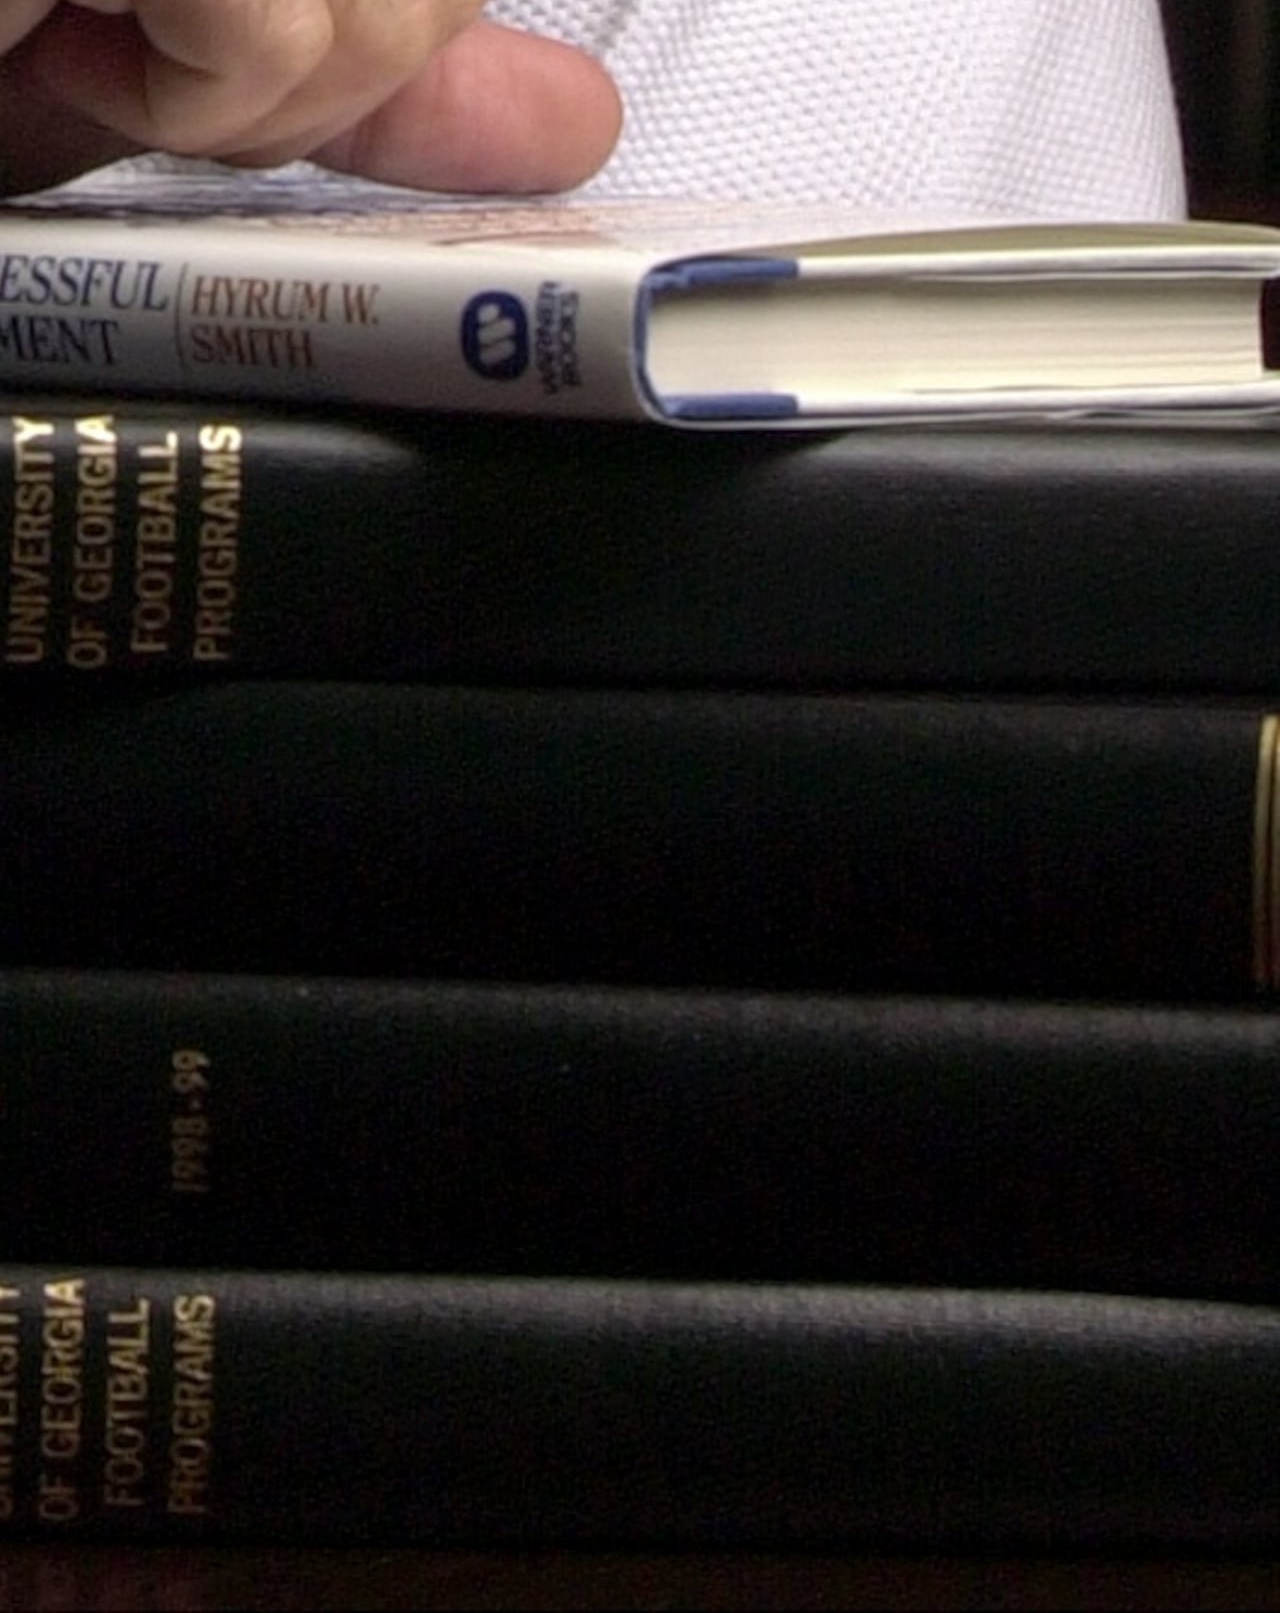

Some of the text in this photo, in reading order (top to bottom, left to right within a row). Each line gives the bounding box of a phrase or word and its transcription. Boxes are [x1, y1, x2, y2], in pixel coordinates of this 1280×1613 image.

[190, 275, 381, 325] HYRUM W.
[191, 326, 315, 368] SMITH
[6, 415, 55, 664] UNIVERSITY
[66, 414, 117, 669] OF GEORGIA
[132, 430, 179, 652] FOOTBALL
[193, 423, 242, 661] PROGRAMS
[39, 1278, 86, 1522] OF GEORGIA
[105, 1297, 152, 1508] FOOTBALL
[168, 1294, 217, 1515] PROGRAMS
